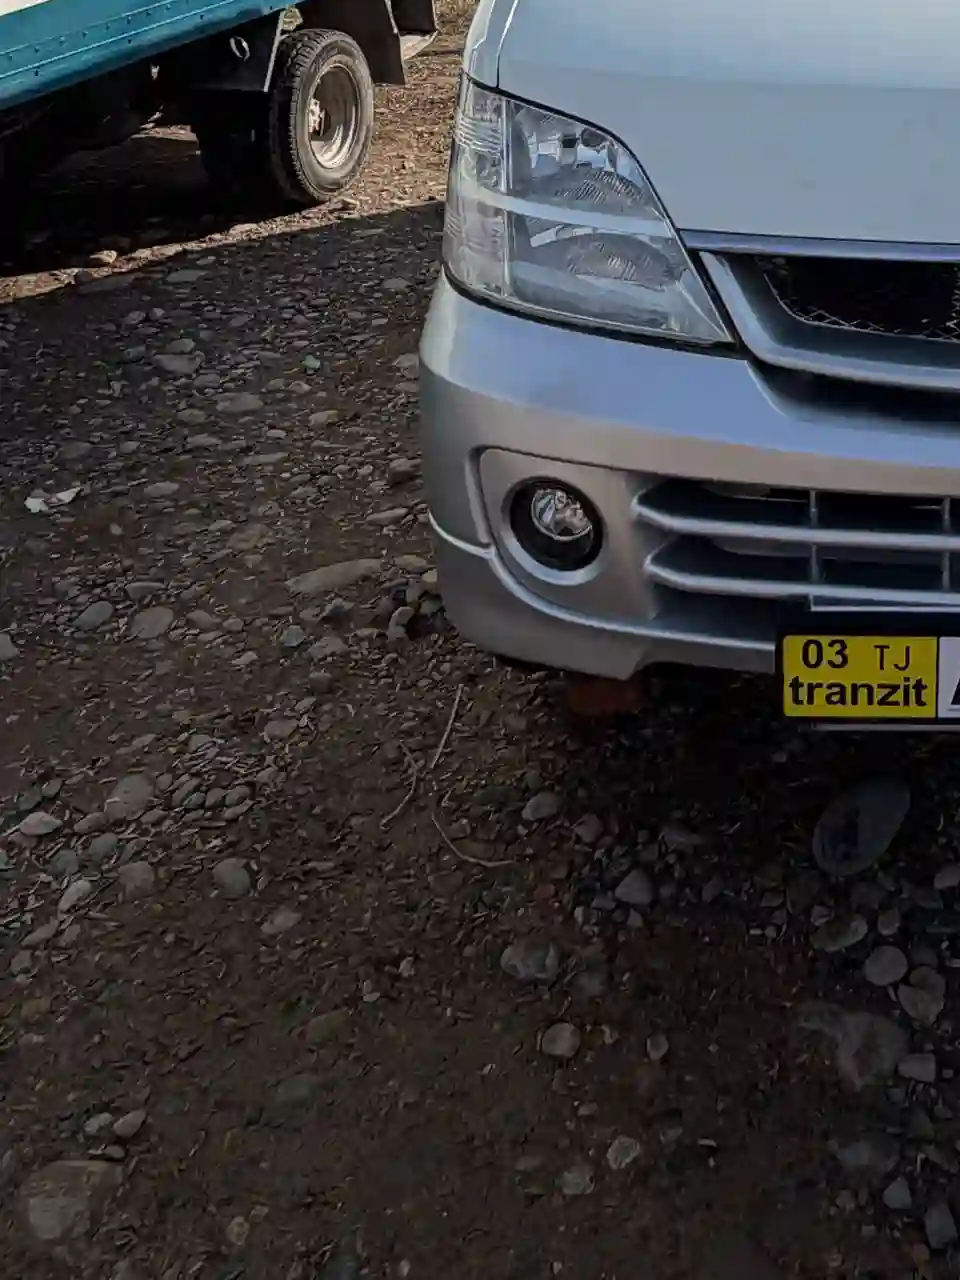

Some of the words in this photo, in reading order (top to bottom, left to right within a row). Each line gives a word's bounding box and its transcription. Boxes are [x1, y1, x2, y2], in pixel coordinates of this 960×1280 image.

[801, 639, 849, 669] 03
[873, 644, 911, 672] TJ
[788, 675, 928, 708] tranzit
